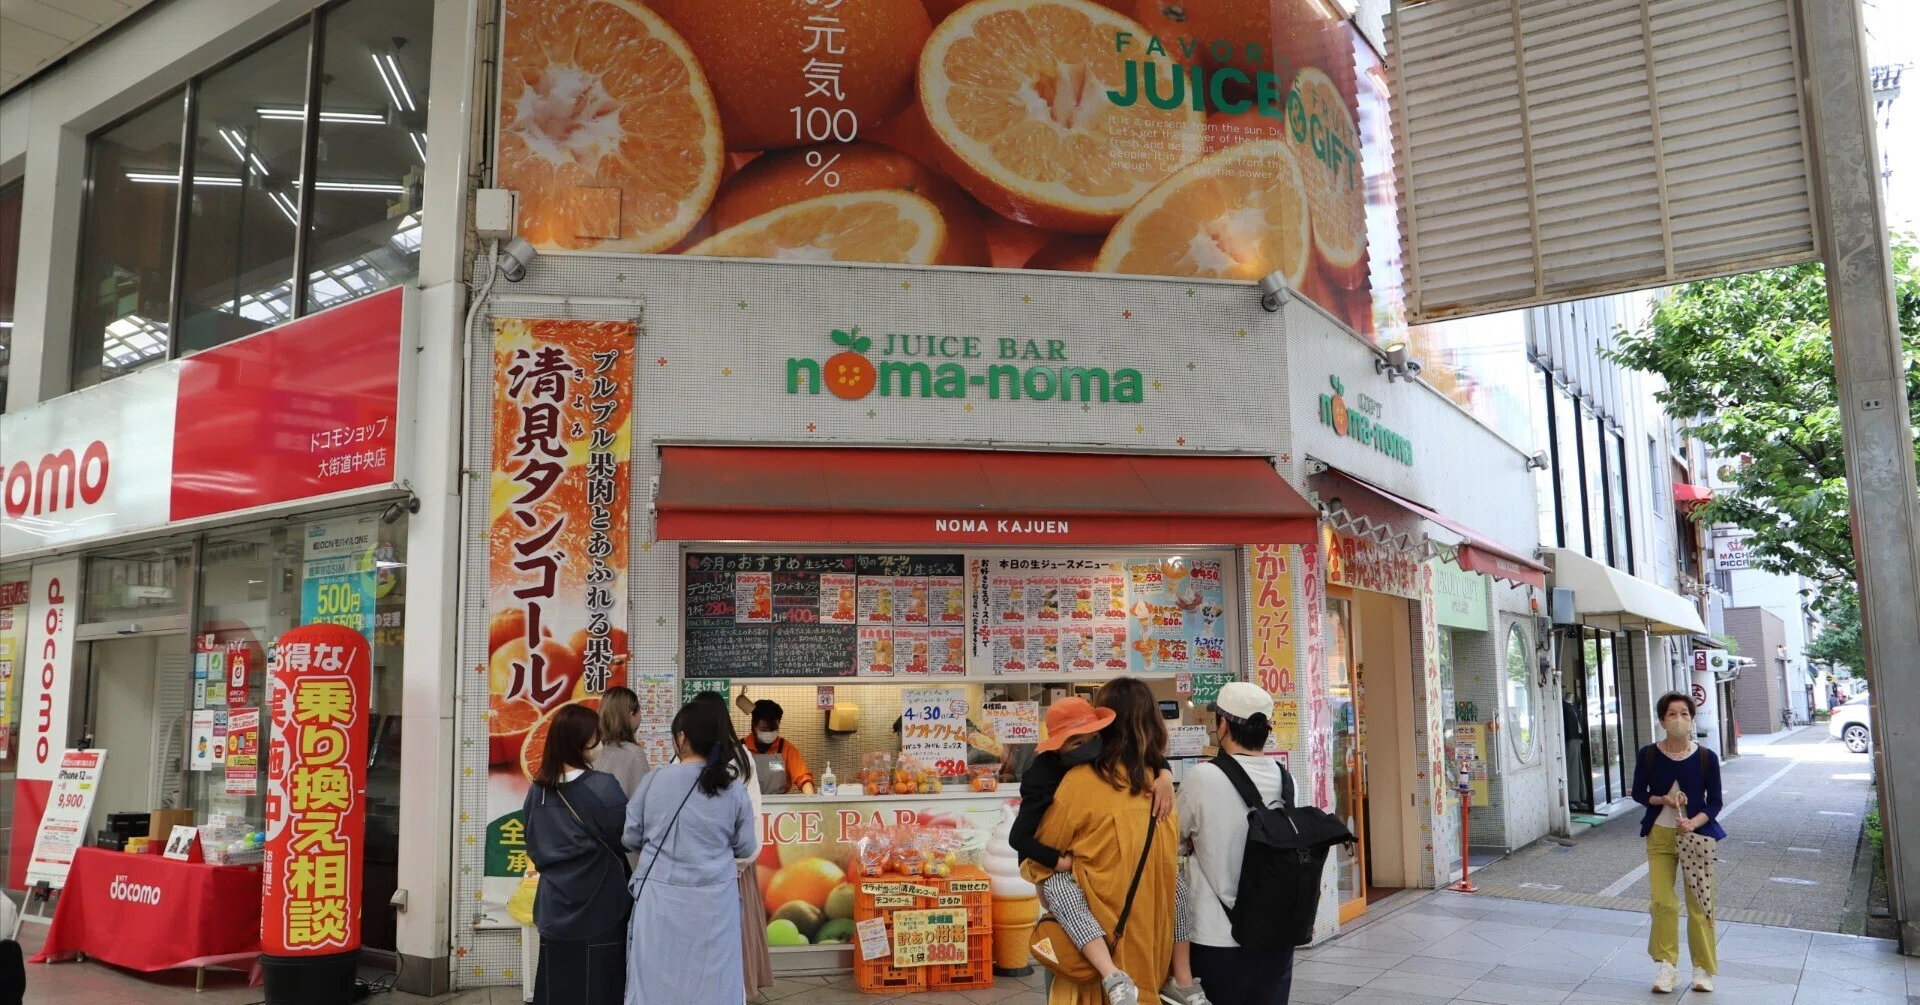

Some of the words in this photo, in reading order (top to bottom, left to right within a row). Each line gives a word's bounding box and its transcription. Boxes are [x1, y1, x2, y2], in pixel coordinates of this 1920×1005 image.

[1106, 59, 1285, 121] JUICE
[1310, 113, 1357, 193] GIFT
[1108, 115, 1116, 124] It
[1121, 116, 1129, 126] is
[1144, 119, 1186, 131] present
[1222, 123, 1240, 133] the
[1244, 126, 1265, 136] sun.
[1110, 137, 1139, 148] fresh
[1143, 140, 1164, 150] and
[1140, 129, 1157, 139] get
[1219, 134, 1231, 144] of
[1234, 135, 1252, 145] the
[1166, 152, 1175, 162] is
[1216, 167, 1235, 177] the
[1239, 169, 1272, 180] power
[883, 333, 982, 359] JUICE
[998, 337, 1067, 361] BAR
[785, 350, 1144, 404] noma-noma
[571, 367, 585, 438] きよみ
[310, 416, 389, 454] ドコモショップ
[1319, 391, 1414, 468] noma-noma
[317, 447, 388, 478] 大街道中央店
[506, 348, 574, 706] 清見タンゴール
[582, 349, 619, 694] プルプル果肉とあふれる果汁
[935, 518, 989, 534] NOMA
[997, 519, 1070, 534] KAJUEN
[353, 534, 369, 545] ONE
[700, 553, 801, 571] 今月のおすすめ
[804, 558, 846, 569] 生ジュース
[914, 563, 956, 575] 生ジュース
[998, 558, 1110, 570] 本日の生ジュースメニュー
[316, 582, 361, 615] 500円
[687, 605, 704, 617] 1杯
[704, 601, 736, 617] 280円
[773, 611, 787, 623] 1杯
[785, 608, 819, 624] 400円
[1272, 610, 1292, 650] ソフト
[1256, 613, 1275, 668] クリーム
[36, 577, 65, 764] docomo
[1193, 673, 1235, 686] ①ご注文
[1257, 667, 1296, 694] 300円
[904, 723, 967, 743] ソフトクリーム
[905, 742, 922, 750] バニラ
[942, 742, 962, 750] ミックス
[58, 769, 78, 780] iPhone
[78, 770, 86, 780] 12
[58, 793, 84, 808] 9,900
[289, 680, 352, 944] 乗り換え相談
[109, 874, 161, 906] docomo
[900, 883, 938, 897] 清見タンゴール
[939, 896, 961, 905] はるか
[897, 924, 966, 946] 訳あり柑橘
